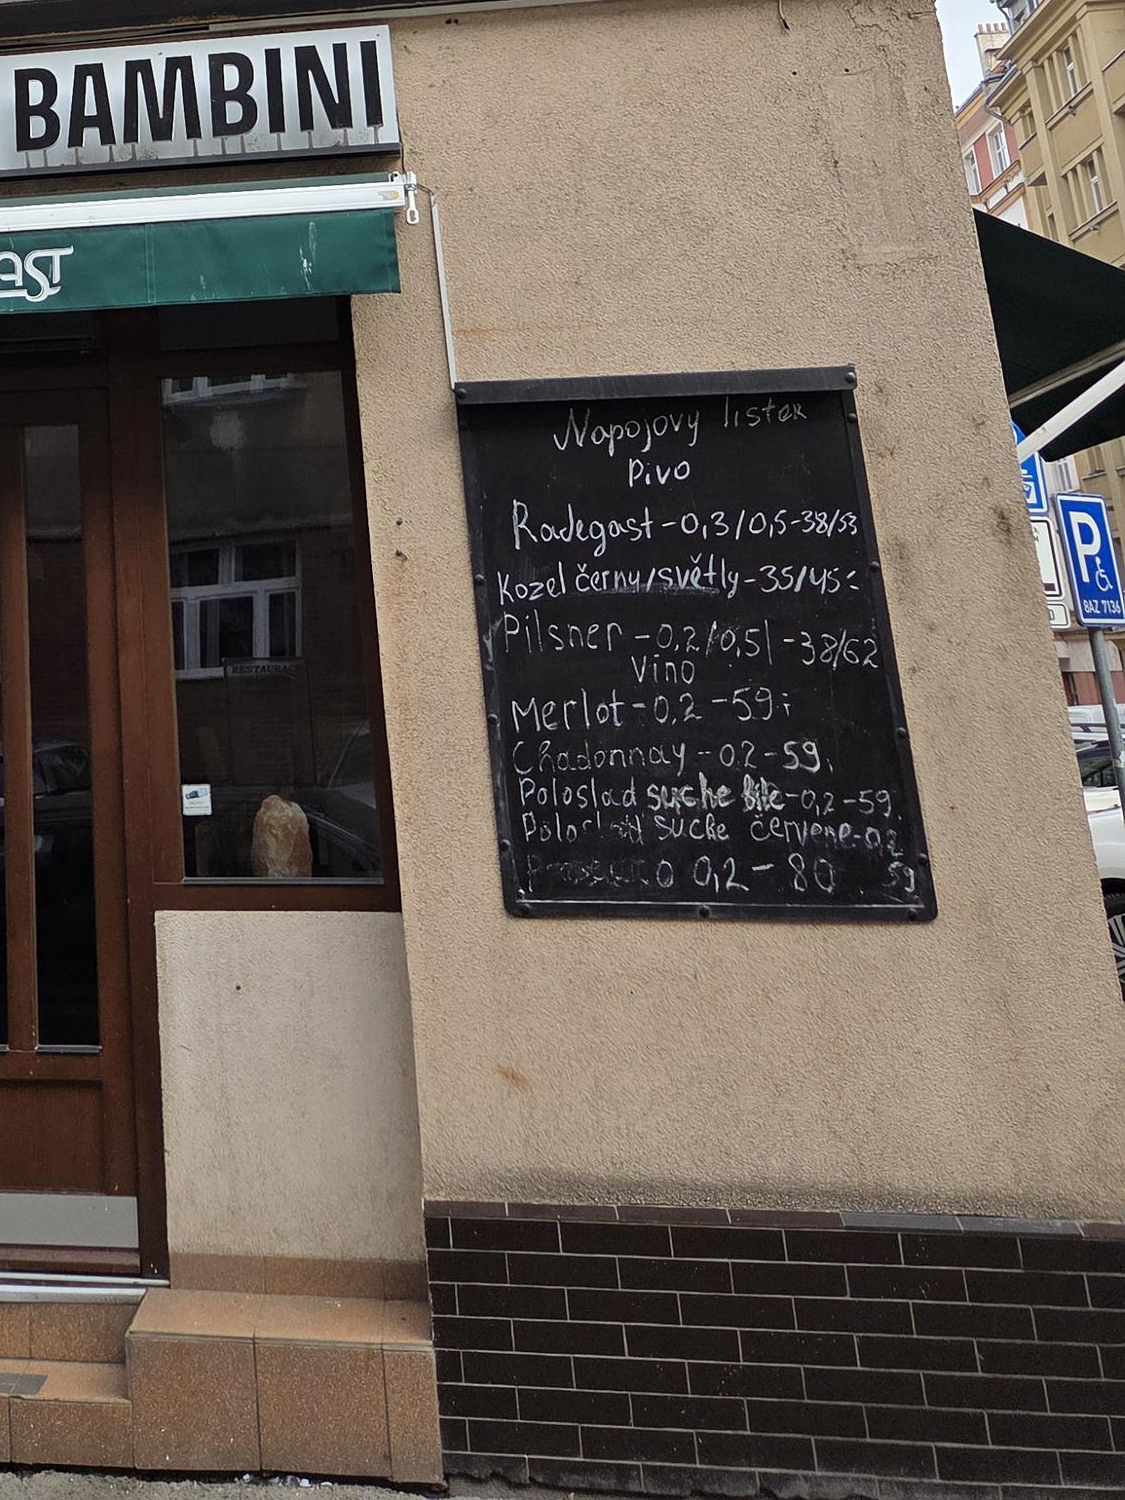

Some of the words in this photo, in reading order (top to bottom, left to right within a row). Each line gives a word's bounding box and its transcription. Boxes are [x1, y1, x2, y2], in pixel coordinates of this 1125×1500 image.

[13, 39, 384, 152] BAMBINI
[724, 396, 807, 428] listek
[628, 457, 691, 488] Pivo
[1068, 510, 1102, 583] P
[497, 561, 566, 605] Kozel
[503, 609, 623, 653] Pilsner
[510, 687, 625, 733] Merlot
